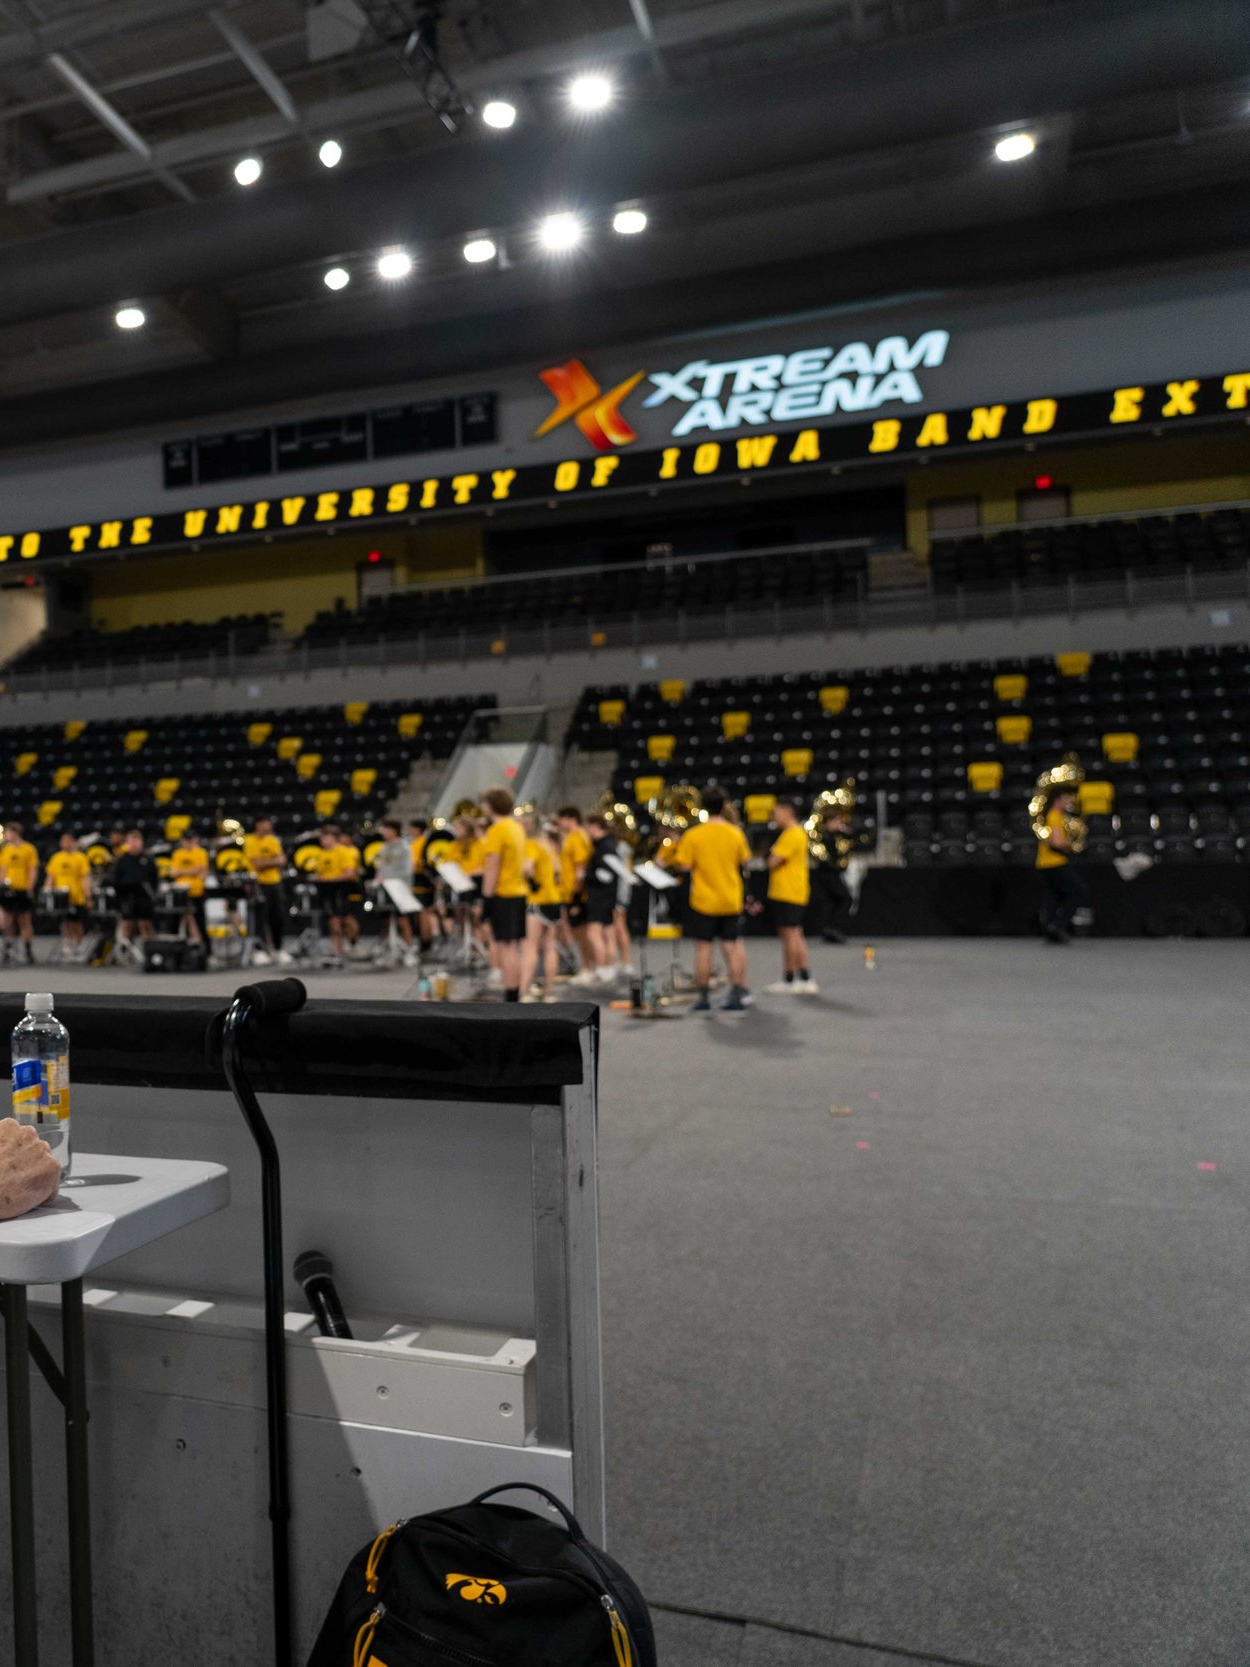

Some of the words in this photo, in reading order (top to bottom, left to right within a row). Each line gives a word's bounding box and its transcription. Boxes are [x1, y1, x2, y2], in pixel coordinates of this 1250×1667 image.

[642, 329, 949, 408] XTREAM
[671, 369, 924, 437] ARENA
[69, 517, 153, 552] THE
[183, 469, 517, 538] UNIVERSITY
[554, 455, 620, 492] OF
[659, 429, 821, 480] IOWA
[868, 398, 1058, 453] BAND
[1109, 372, 1250, 424] EXT
